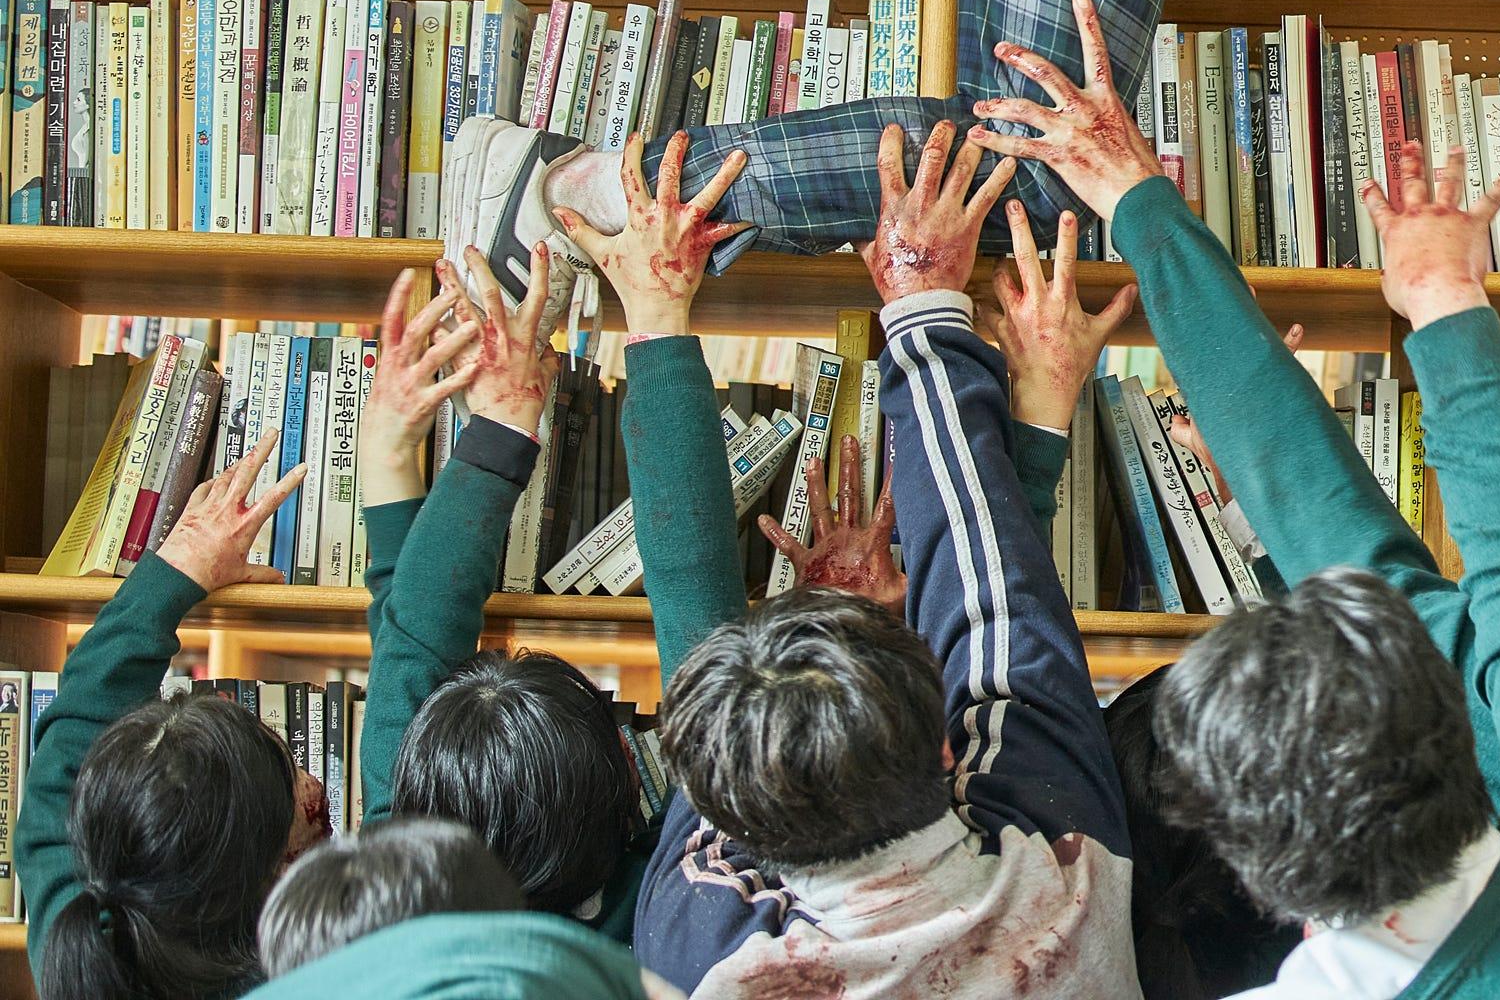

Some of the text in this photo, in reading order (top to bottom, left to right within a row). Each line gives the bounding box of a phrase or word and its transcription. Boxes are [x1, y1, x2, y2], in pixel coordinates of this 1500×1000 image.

[26, 2, 35, 12] 18
[22, 16, 39, 59] 제2의
[112, 32, 125, 52] 꿈꾸는
[198, 33, 212, 56] 공부
[217, 0, 238, 83] 오만과 편견
[366, 1, 384, 97] 서울 여기가 좋다
[622, 14, 643, 73] 우리들의
[802, 13, 823, 98] 교육학개론
[869, 0, 892, 91] 世界名歌
[48, 23, 67, 137] 내집마련 기술
[449, 47, 464, 83] 성공선택
[559, 40, 581, 94] 도가니
[581, 54, 597, 93] 하나님의
[773, 63, 785, 100] 어머니의
[1236, 53, 1246, 108] 김일성
[388, 72, 400, 100] 조선사
[617, 80, 631, 112] 젊은
[1267, 46, 1286, 153] 강명자 삼신할미
[242, 99, 254, 122] 이상
[1164, 115, 1178, 143] 버스
[1347, 60, 1370, 181] 김홍신 인생사용설명서
[343, 102, 359, 178] 17일 다이어트
[1384, 95, 1404, 181] 디테일에 집중하라
[345, 190, 355, 231] 17DAY DIET
[272, 368, 284, 381] 더
[311, 374, 328, 401] 사기
[824, 362, 837, 374] '96
[247, 360, 267, 442] 다시 쓰는 이야기
[287, 386, 304, 432] 군주론
[331, 349, 357, 471] 고운이름한글이름
[131, 387, 166, 471] 풍수지리
[812, 417, 825, 427] 20
[1184, 458, 1197, 474] 5
[1413, 438, 1424, 460] 엄마
[339, 475, 353, 503] 배우리
[1412, 480, 1423, 520] 맞아?
[592, 529, 616, 551] 상자
